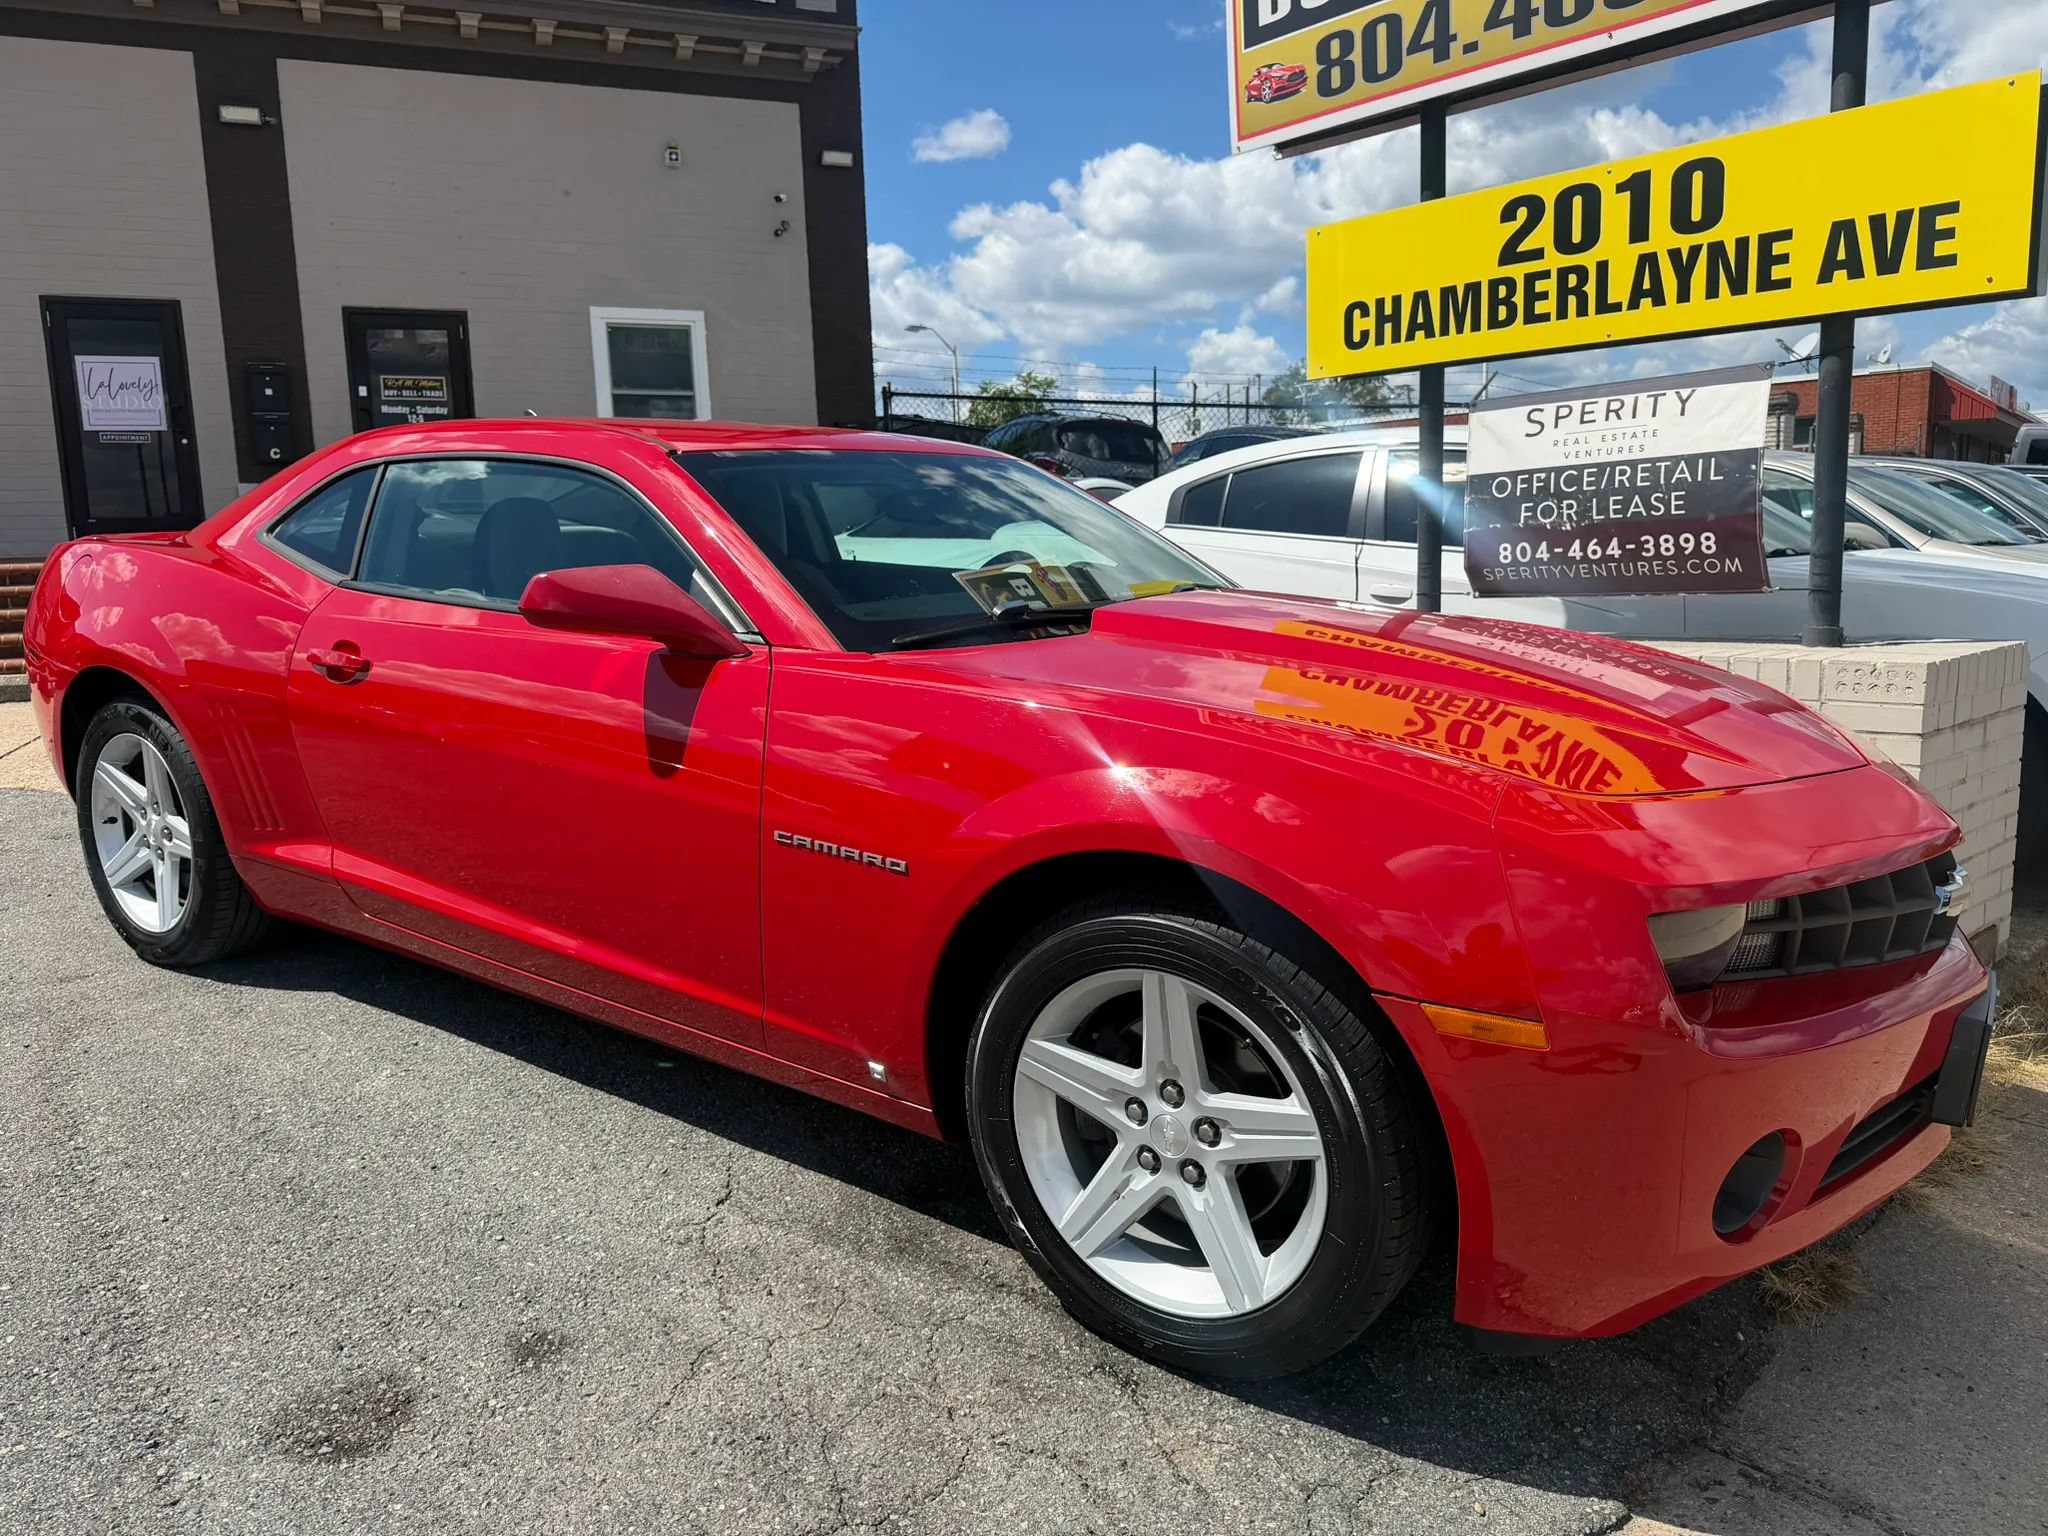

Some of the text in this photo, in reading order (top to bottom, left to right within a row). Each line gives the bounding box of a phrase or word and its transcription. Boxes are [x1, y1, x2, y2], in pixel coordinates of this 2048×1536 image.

[1316, 0, 1645, 98] 804.4
[1497, 156, 1726, 267] 2010
[1343, 201, 1960, 350] CHAMBERLAYNE AVE
[82, 394, 162, 410] STUDIO
[384, 389, 444, 398] BUY SELL TRADE
[381, 405, 410, 415] Monday
[416, 405, 449, 416] Saturday
[1525, 389, 1697, 437] SPERITY
[269, 448, 281, 459] C
[1553, 429, 1659, 448] REAL ESTATE
[1564, 444, 1646, 460] VENTURES
[1492, 457, 1724, 499] OFFICE/RETAIL
[1520, 491, 1686, 525] FOR LEASE
[1499, 532, 1718, 564] 804-464-3898
[1483, 556, 1743, 582] SPERITYVENTURES.COM
[774, 830, 908, 873] CAMARO
